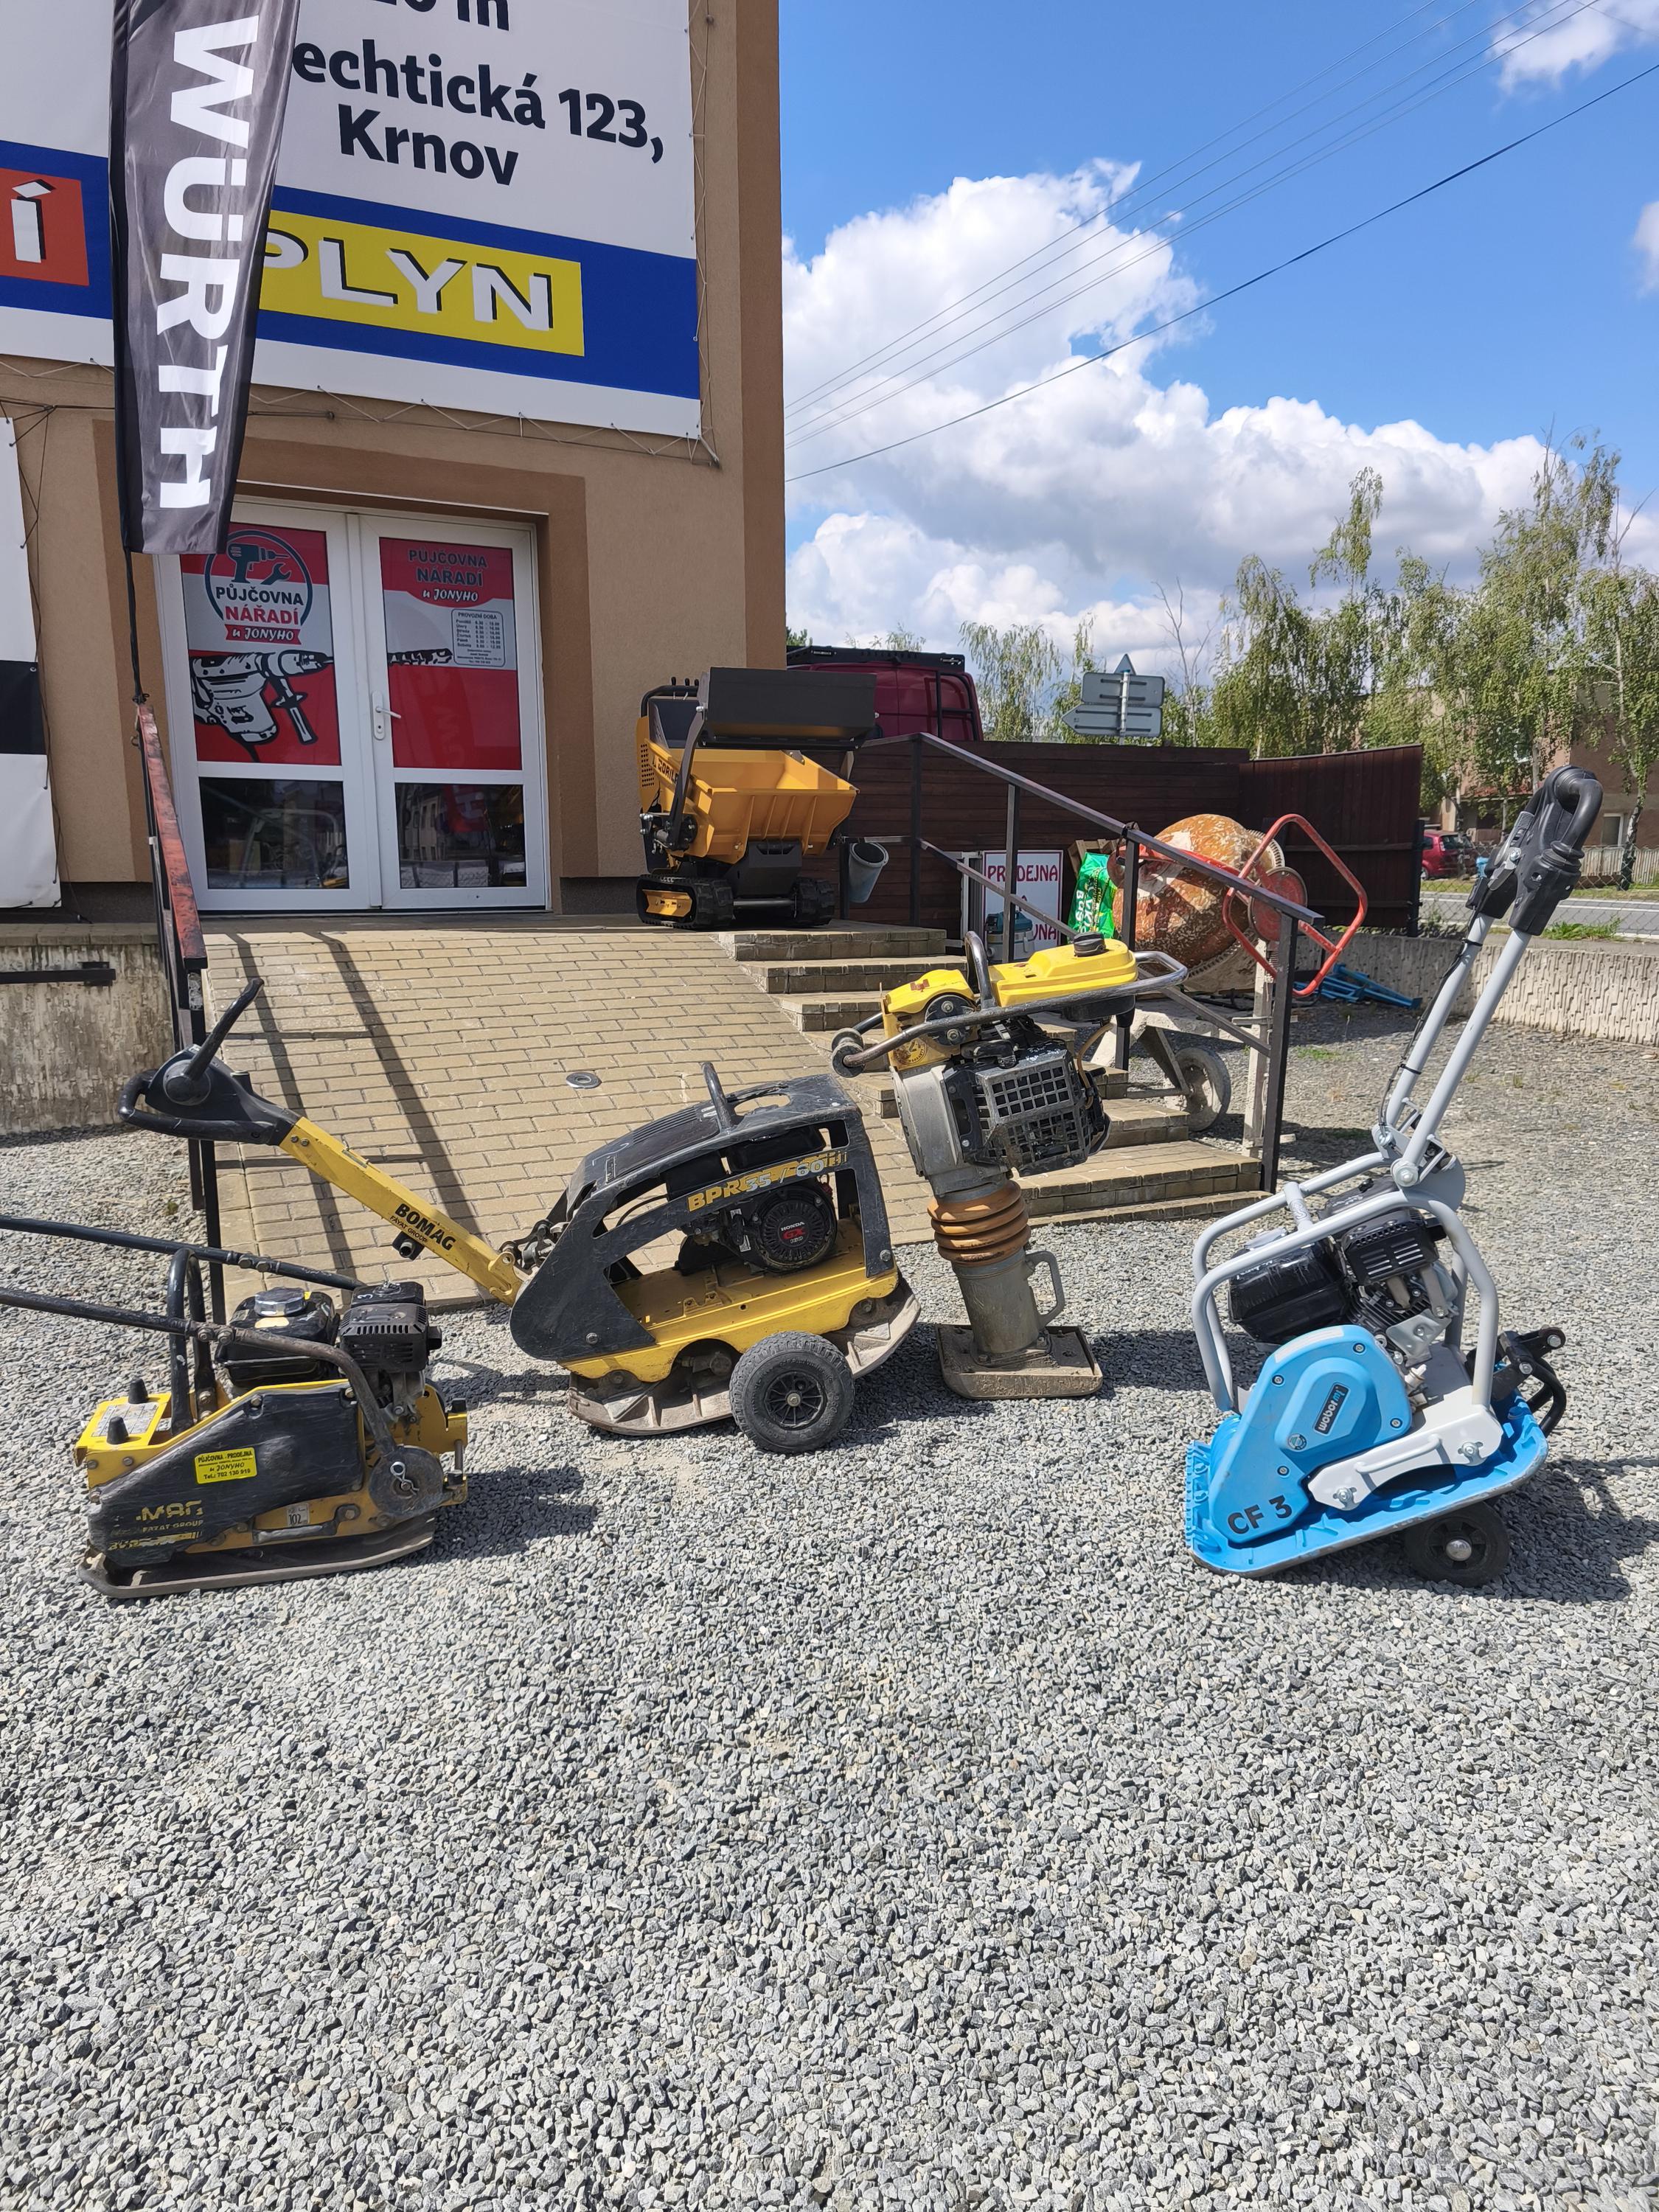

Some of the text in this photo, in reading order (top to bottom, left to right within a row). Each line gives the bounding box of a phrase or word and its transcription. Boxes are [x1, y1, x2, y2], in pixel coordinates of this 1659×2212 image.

[292, 39, 664, 164] echtická 123,
[338, 103, 519, 186] Krnov
[156, 15, 259, 508] WÜRTH
[408, 547, 487, 568] PŮJČOVNA
[417, 566, 483, 587] NÁŘADÍ
[215, 583, 305, 606] PŮJČOVNA
[422, 588, 479, 602] u JONYHO
[225, 604, 299, 625] NÁŘADÍ
[232, 627, 294, 641] u JONYHO
[987, 865, 1058, 882] PRDEJNA
[795, 1159, 824, 1178] 60
[390, 1215, 428, 1243] FAYAT GROUP
[395, 1203, 456, 1251] BOMAG
[780, 1221, 805, 1231] HONDA
[226, 1450, 253, 1459] PRODEJNA
[216, 1462, 245, 1471] JONYHO
[1227, 1495, 1293, 1534] CF 3
